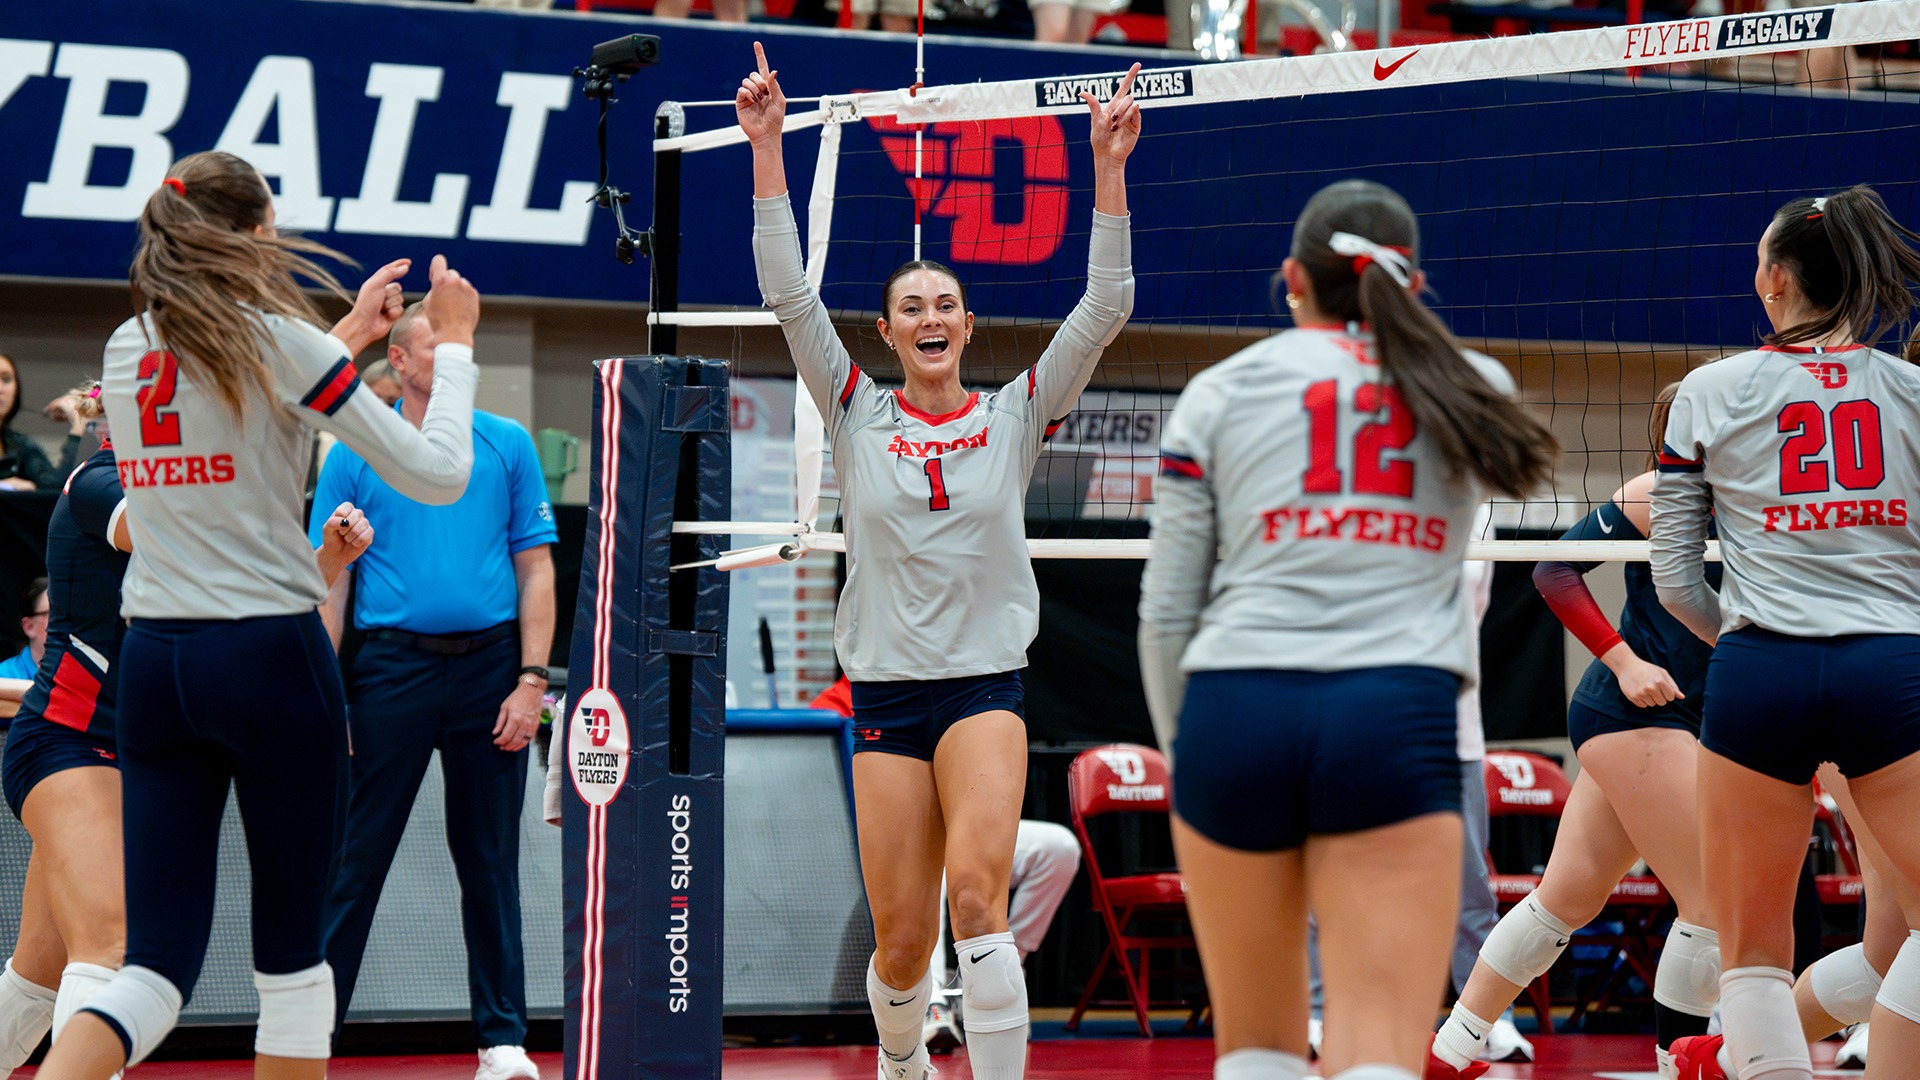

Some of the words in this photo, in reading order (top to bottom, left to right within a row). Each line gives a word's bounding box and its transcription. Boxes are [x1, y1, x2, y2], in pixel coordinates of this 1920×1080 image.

[1624, 21, 1710, 59] FLYER
[1725, 12, 1823, 47] LEGACY
[1043, 78, 1114, 105] DAYTON
[1115, 72, 1186, 98] LYERS
[136, 350, 182, 447] 2
[1302, 378, 1416, 498] 12
[1777, 398, 1886, 496] 20
[118, 454, 236, 489] FLYERS
[923, 457, 950, 512] 1
[1261, 507, 1449, 554] FLYERS
[1762, 499, 1908, 532] FLYERS
[577, 752, 619, 768] DAYTON
[578, 769, 618, 784] FLYERS
[667, 794, 693, 890] sports
